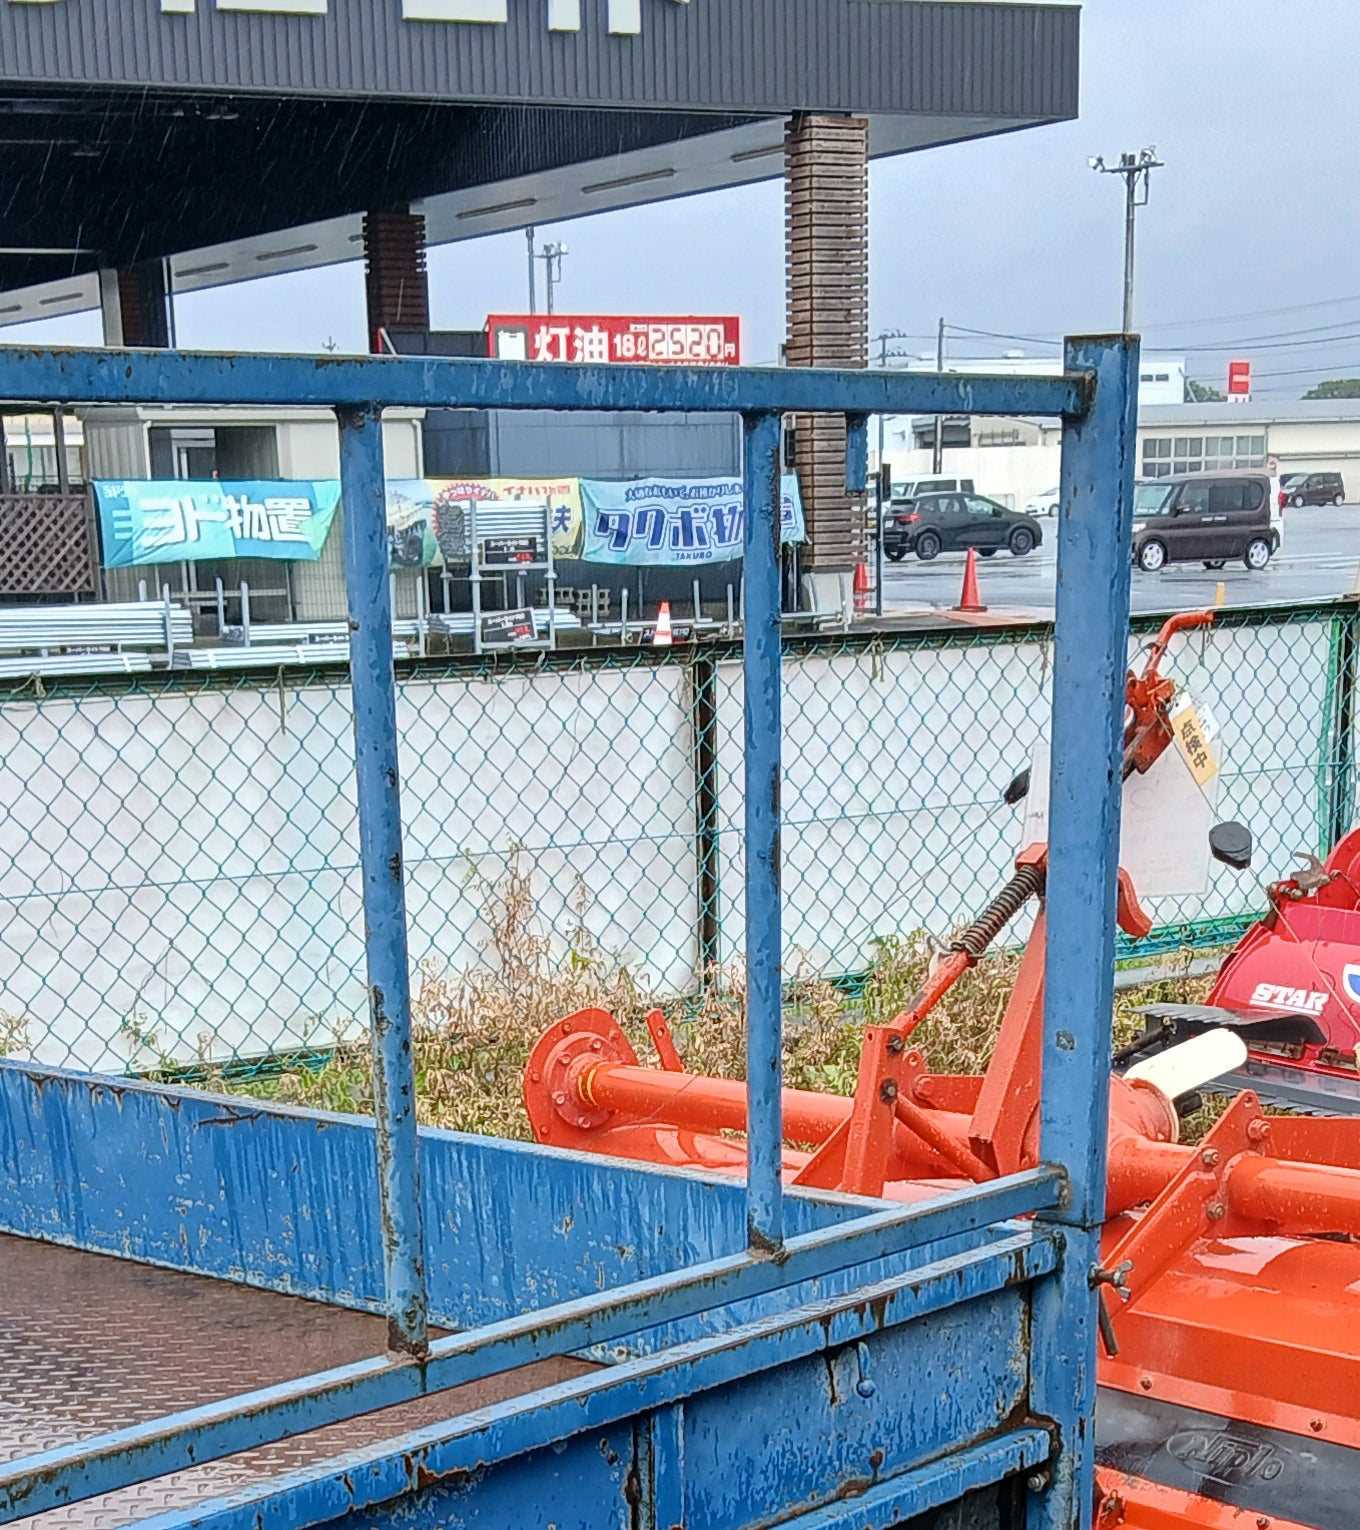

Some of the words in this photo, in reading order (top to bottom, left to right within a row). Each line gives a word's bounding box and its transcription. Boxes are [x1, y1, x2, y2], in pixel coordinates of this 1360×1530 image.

[535, 324, 608, 363] 灯油
[140, 494, 313, 547] ヨド物置
[675, 550, 712, 560] TAKUBO
[1251, 983, 1329, 1012] STAR
[1178, 1432, 1285, 1482] Niplo
